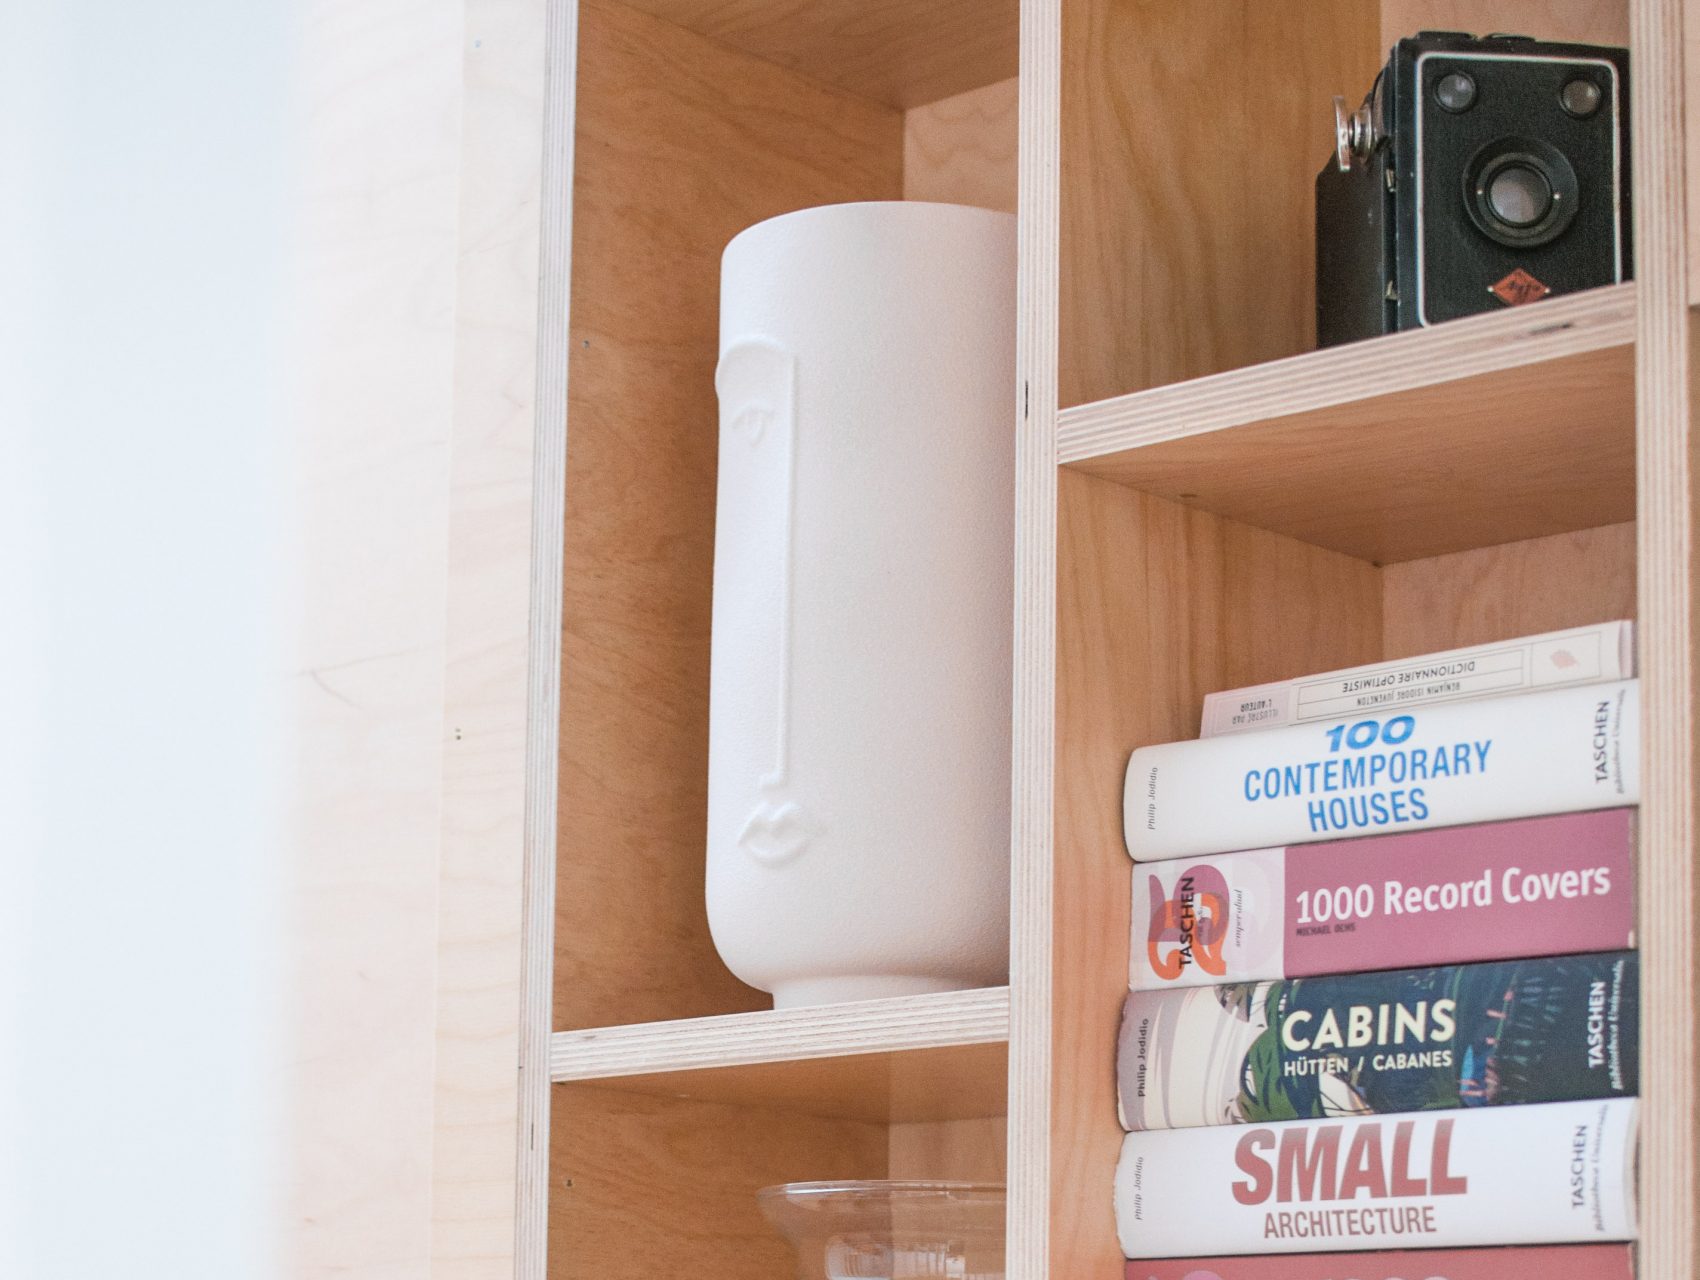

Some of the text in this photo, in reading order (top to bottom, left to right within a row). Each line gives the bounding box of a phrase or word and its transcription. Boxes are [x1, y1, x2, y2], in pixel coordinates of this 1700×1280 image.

[1342, 660, 1476, 693] DICTIONNAIRE OPTIMISTE
[1397, 690, 1424, 701] ISIDORE
[1427, 681, 1461, 695] BENJAMIN
[1325, 715, 1416, 753] 100
[1593, 701, 1610, 784] TASCHEN
[1147, 766, 1159, 831] Philip Jodidio
[1243, 740, 1493, 802] CONTEMPORARY
[1307, 788, 1429, 833] HOUSES
[1178, 876, 1196, 970] TASCHEN
[1295, 866, 1611, 924] 1000 Record Covers
[1281, 998, 1457, 1052] CABINS
[1587, 981, 1606, 1069] TASCHEN
[1137, 1017, 1149, 1098] Philip Jodidio
[1283, 1055, 1349, 1077] HÜTTEN
[1372, 1050, 1453, 1072] CABANES
[1133, 1156, 1144, 1221] Philip Jodidio
[1231, 1118, 1468, 1206] SMALL
[1570, 1125, 1588, 1210] TASCHEN
[1264, 1206, 1437, 1239] ARCHITECTURE
